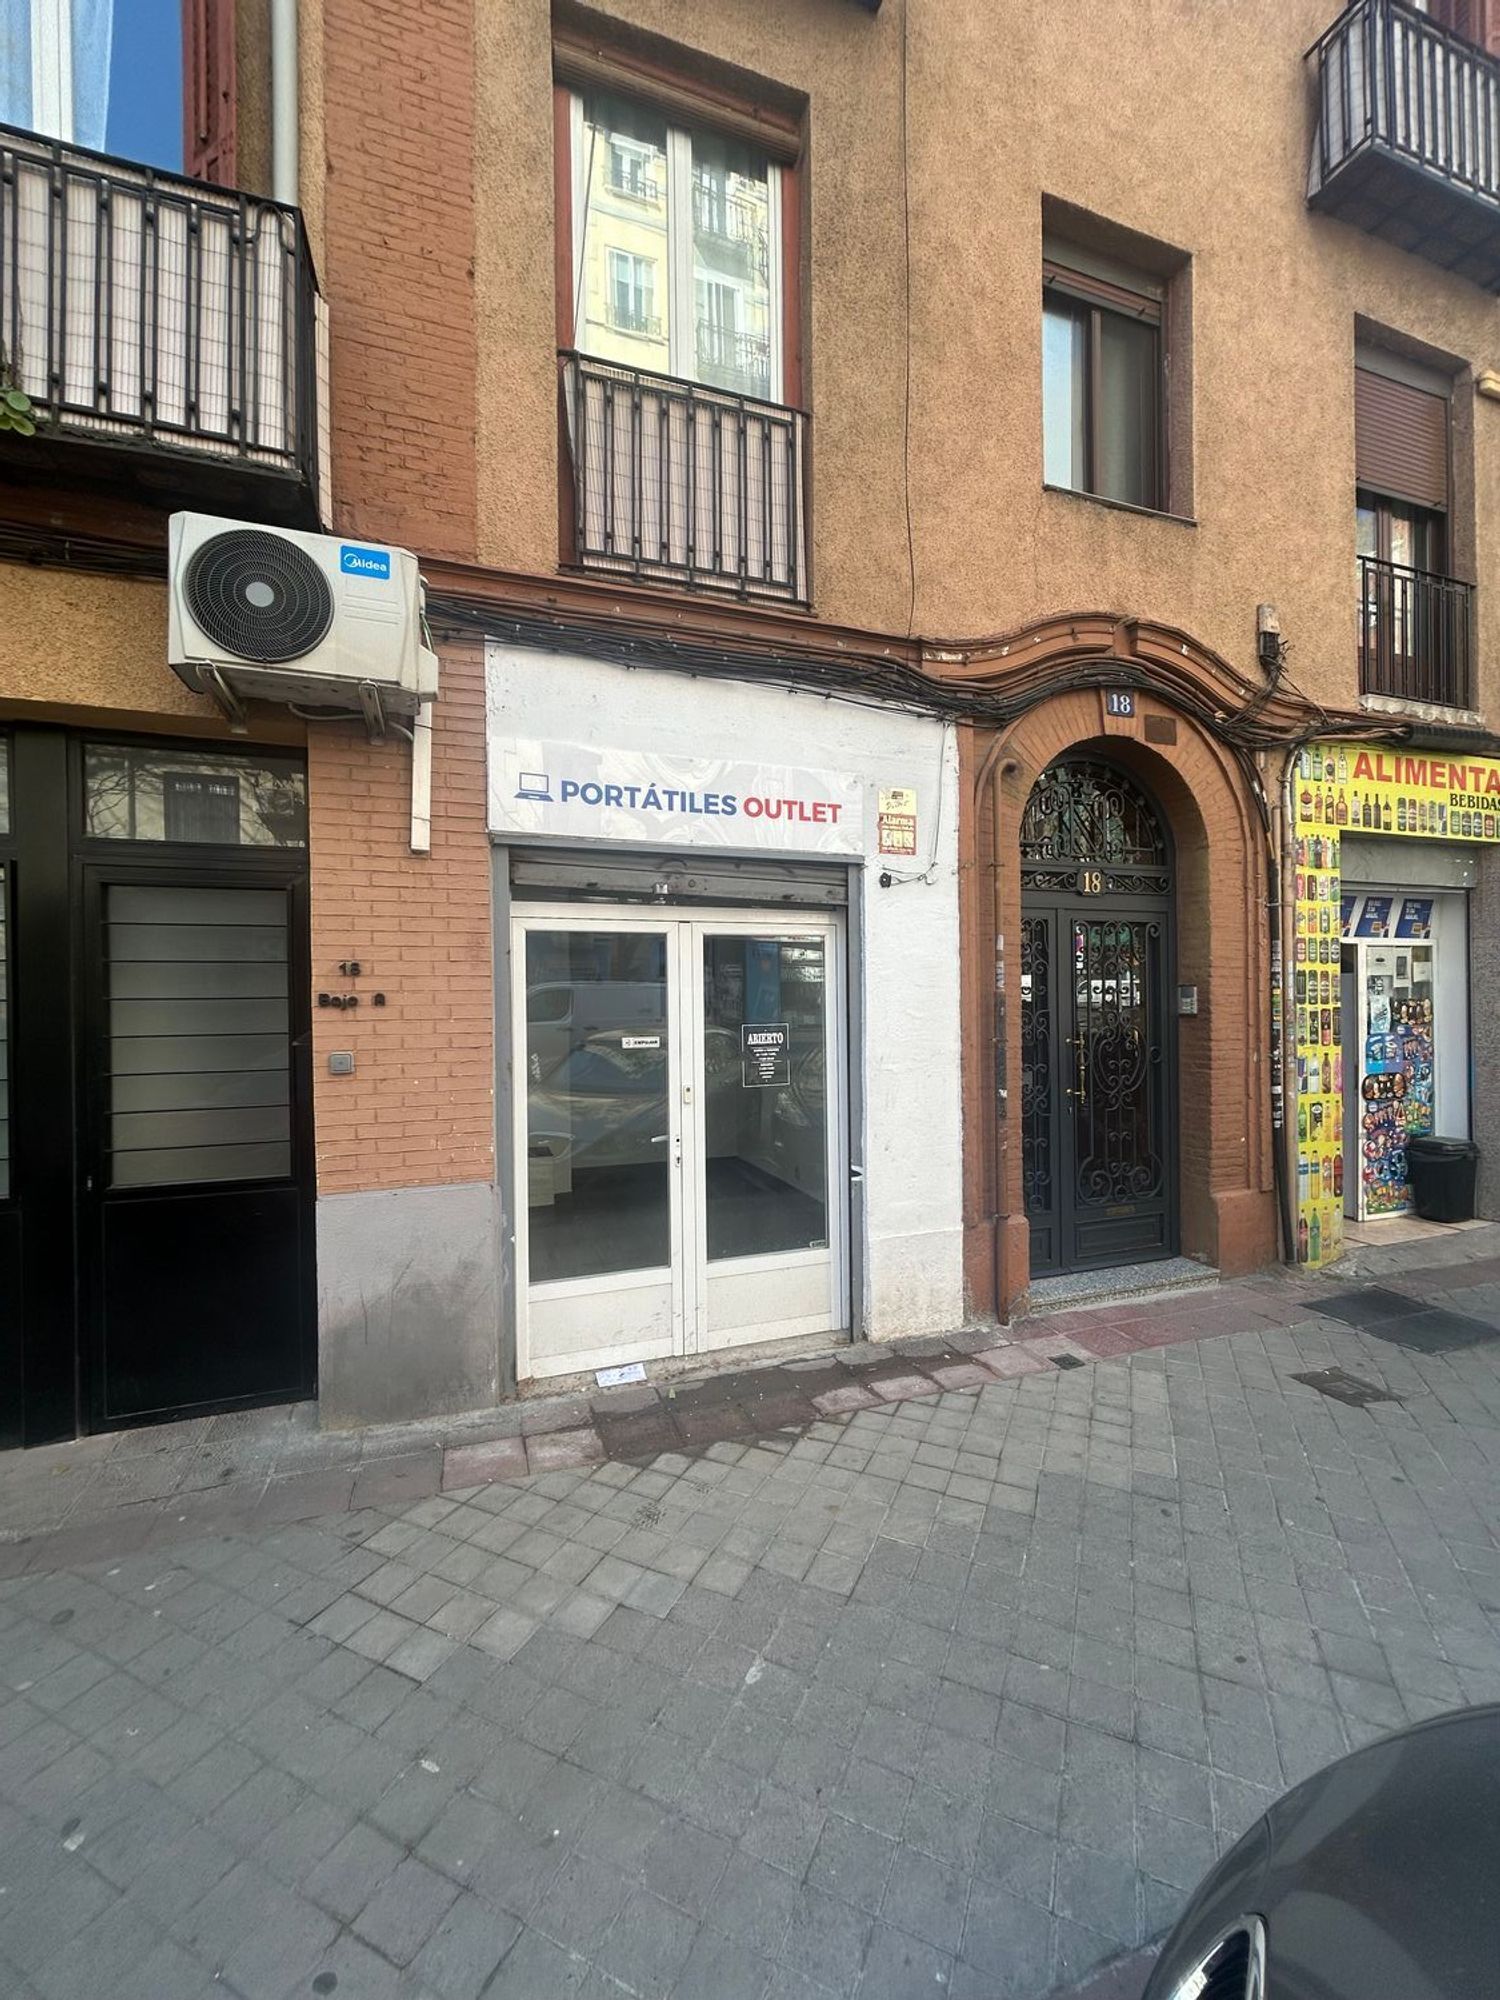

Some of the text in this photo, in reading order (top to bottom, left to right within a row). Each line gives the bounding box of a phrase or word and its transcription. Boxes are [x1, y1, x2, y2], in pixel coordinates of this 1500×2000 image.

[344, 553, 387, 571] Midea
[1112, 694, 1131, 713] 18
[1353, 752, 1500, 794] ALIMENTA
[561, 780, 842, 824] PORTÁTILES OUTLET
[1084, 871, 1101, 893] 18
[747, 1032, 784, 1045] ABIERTO
